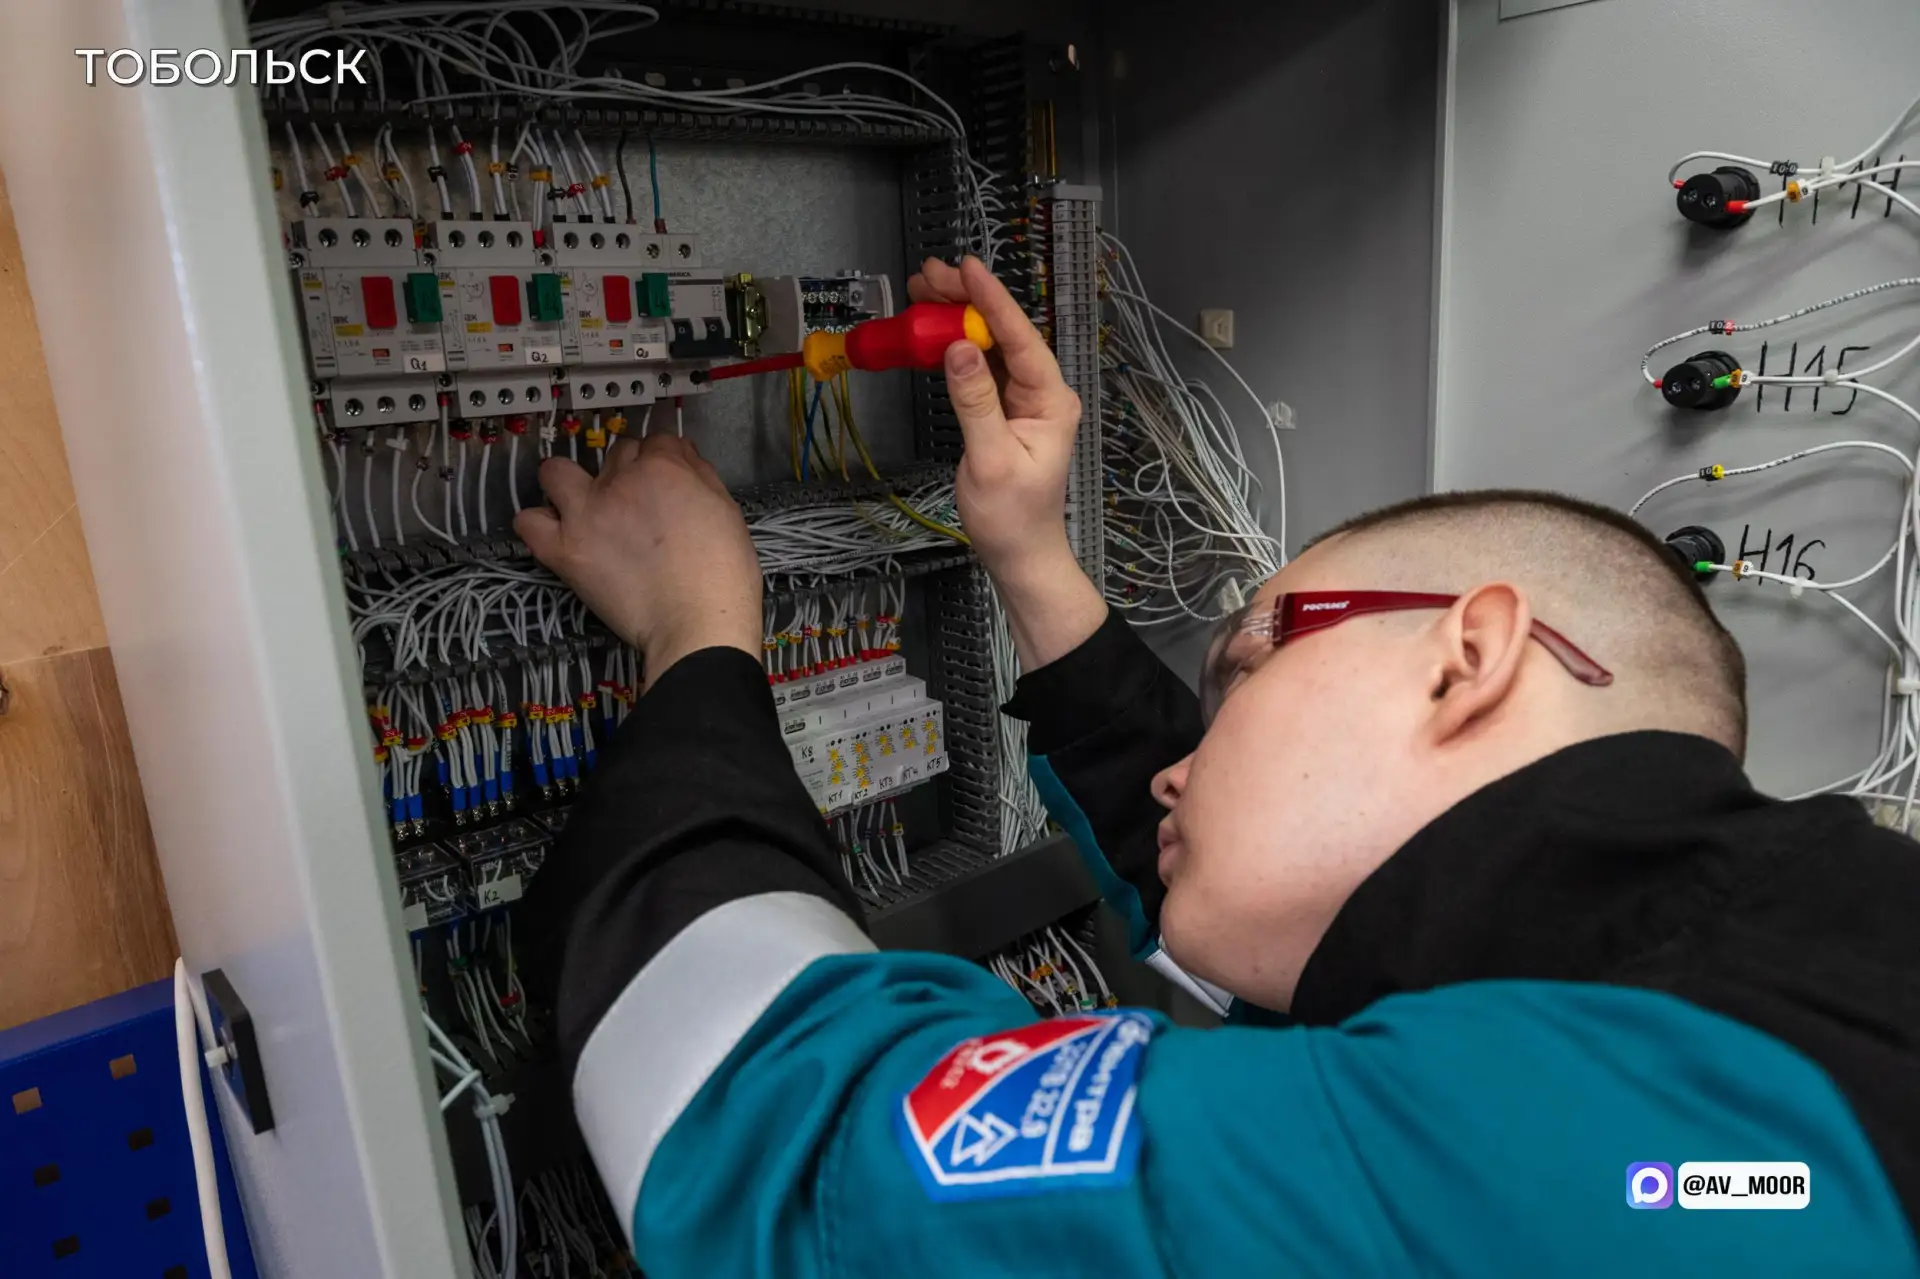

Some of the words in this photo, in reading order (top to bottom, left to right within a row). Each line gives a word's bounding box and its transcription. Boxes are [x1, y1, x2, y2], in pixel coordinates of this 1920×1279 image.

[531, 351, 548, 363] Q2
[410, 358, 428, 371] Q1
[1757, 340, 1870, 415] H15
[1738, 524, 1826, 586] H16
[854, 788, 868, 801] KT2
[484, 890, 500, 904] K2
